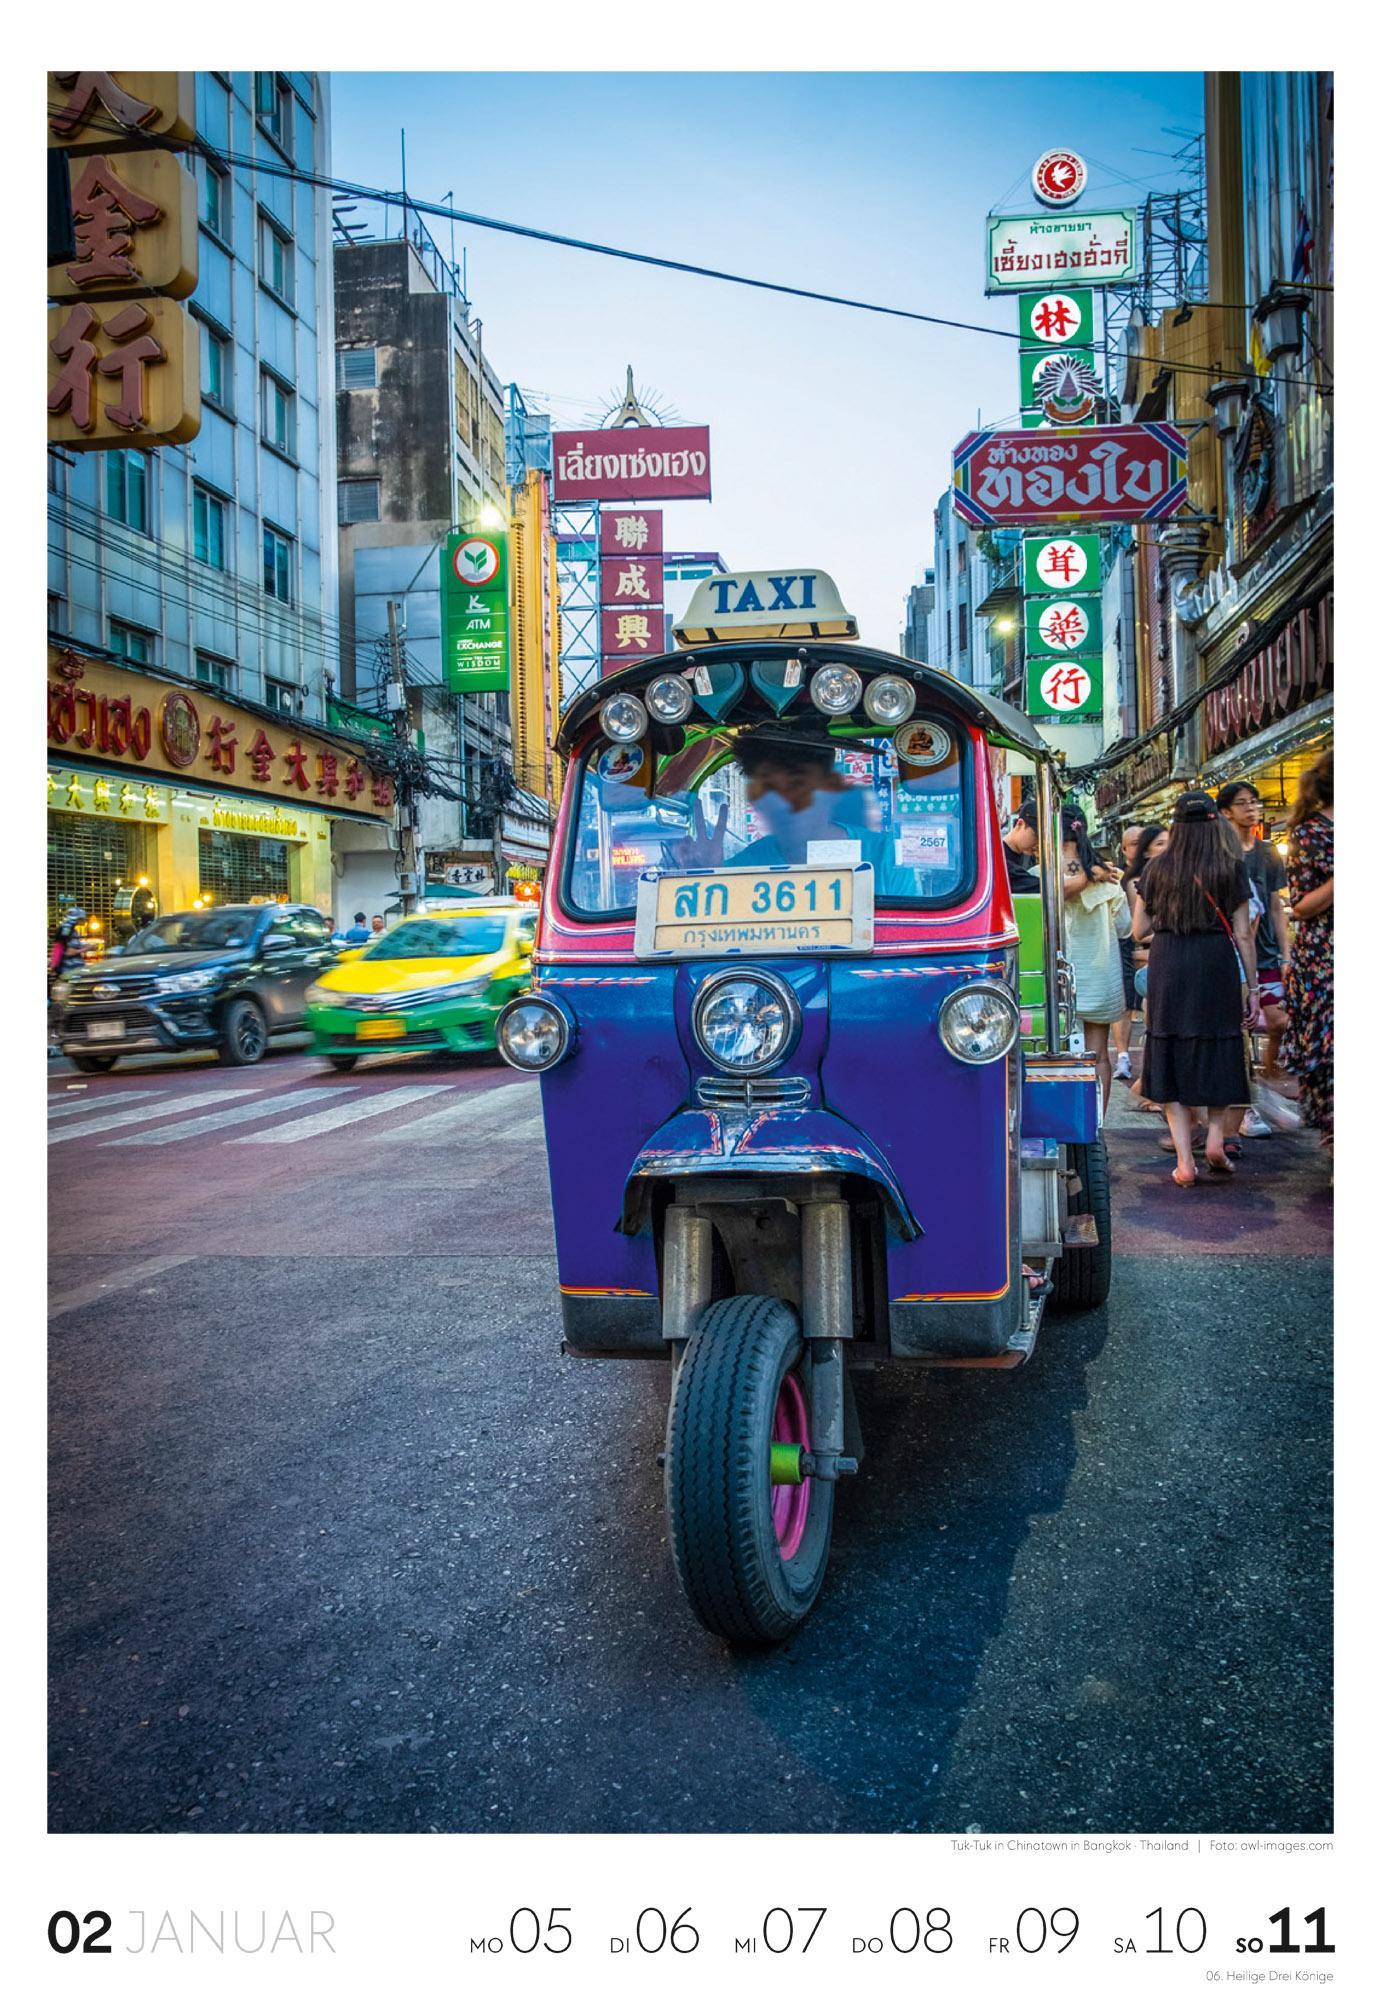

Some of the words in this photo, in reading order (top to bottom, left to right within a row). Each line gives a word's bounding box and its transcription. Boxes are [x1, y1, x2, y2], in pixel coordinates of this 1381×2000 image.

[1035, 300, 1079, 337] 林
[988, 440, 1079, 464] ห้างทอง
[977, 441, 1164, 508] ทองใบ
[614, 515, 651, 648] 聯成興
[709, 575, 817, 614] TAXI
[466, 618, 490, 630] ATM
[457, 640, 502, 650] EXCHANGE
[457, 660, 500, 668] WISDOM
[920, 837, 946, 847] 2567
[674, 881, 728, 918] สก
[751, 878, 842, 914] 3611
[683, 925, 821, 948] กรุงเทพมหานคร
